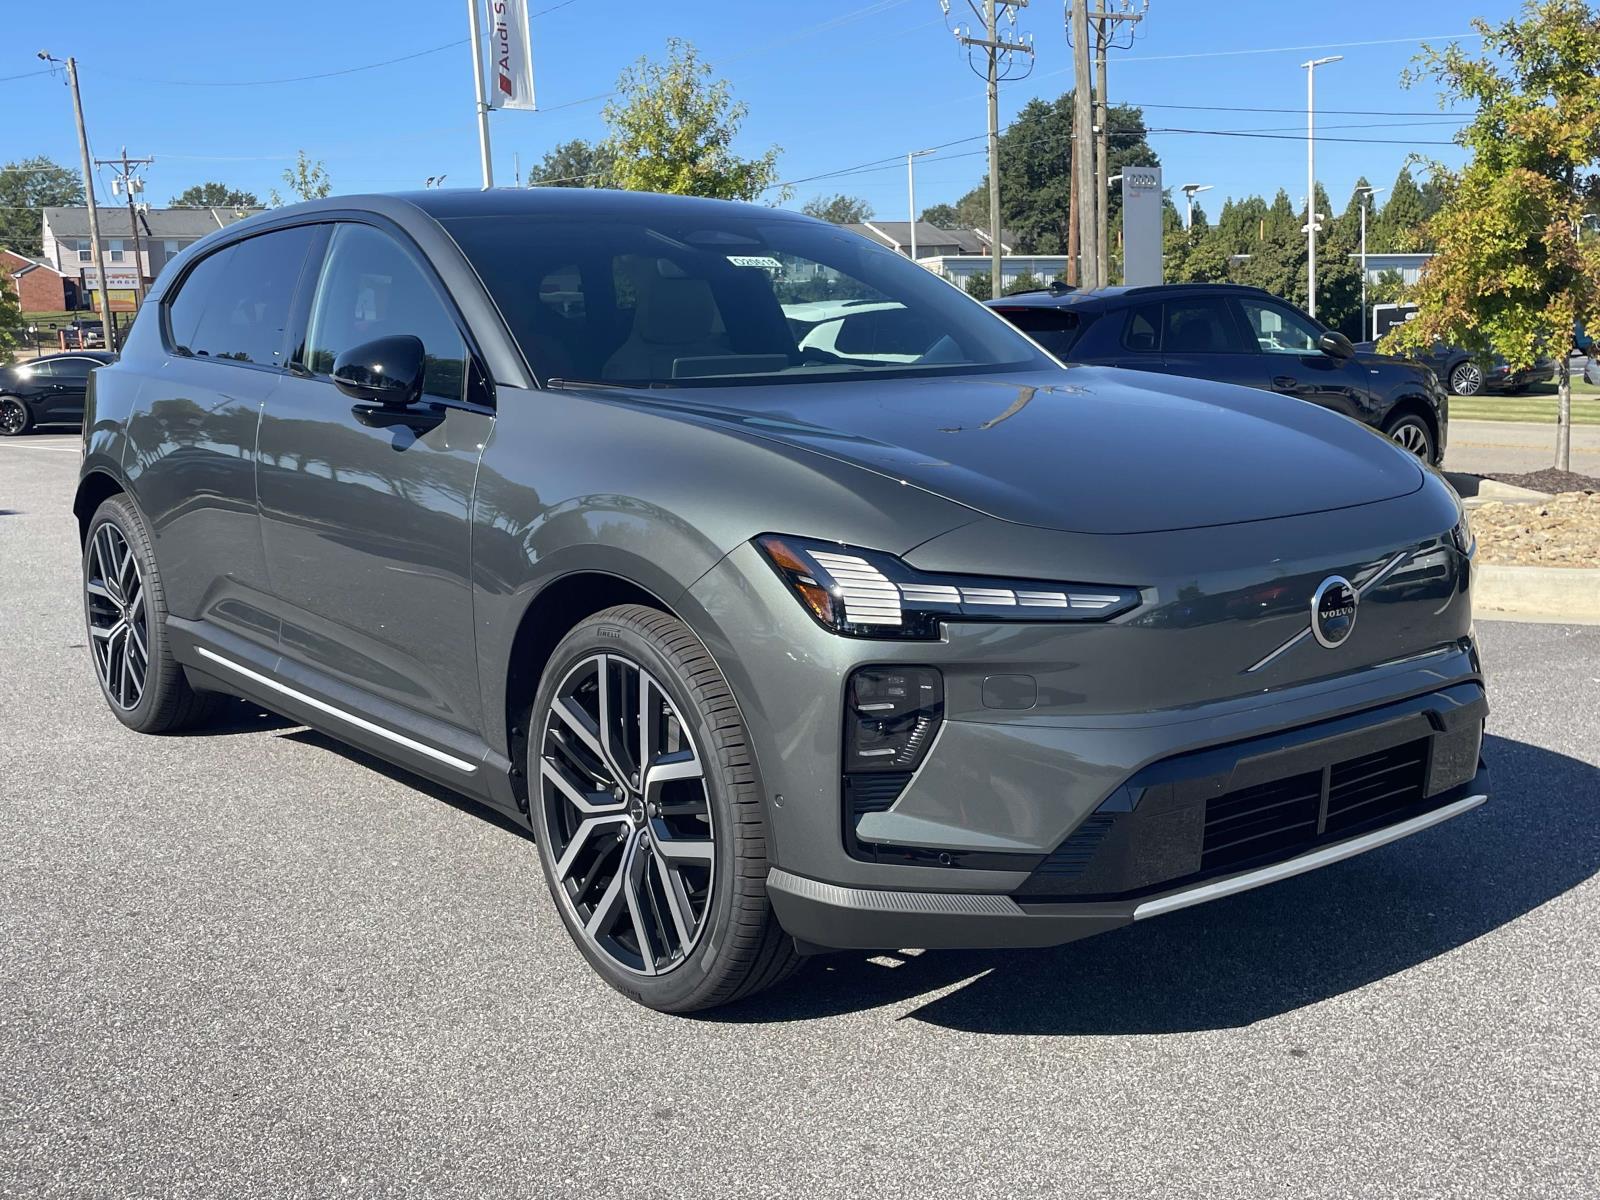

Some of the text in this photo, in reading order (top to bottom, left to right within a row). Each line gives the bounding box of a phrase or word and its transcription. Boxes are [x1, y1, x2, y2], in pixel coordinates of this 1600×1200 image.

[494, 0, 510, 72] Audi S
[1321, 606, 1354, 619] VOLVO
